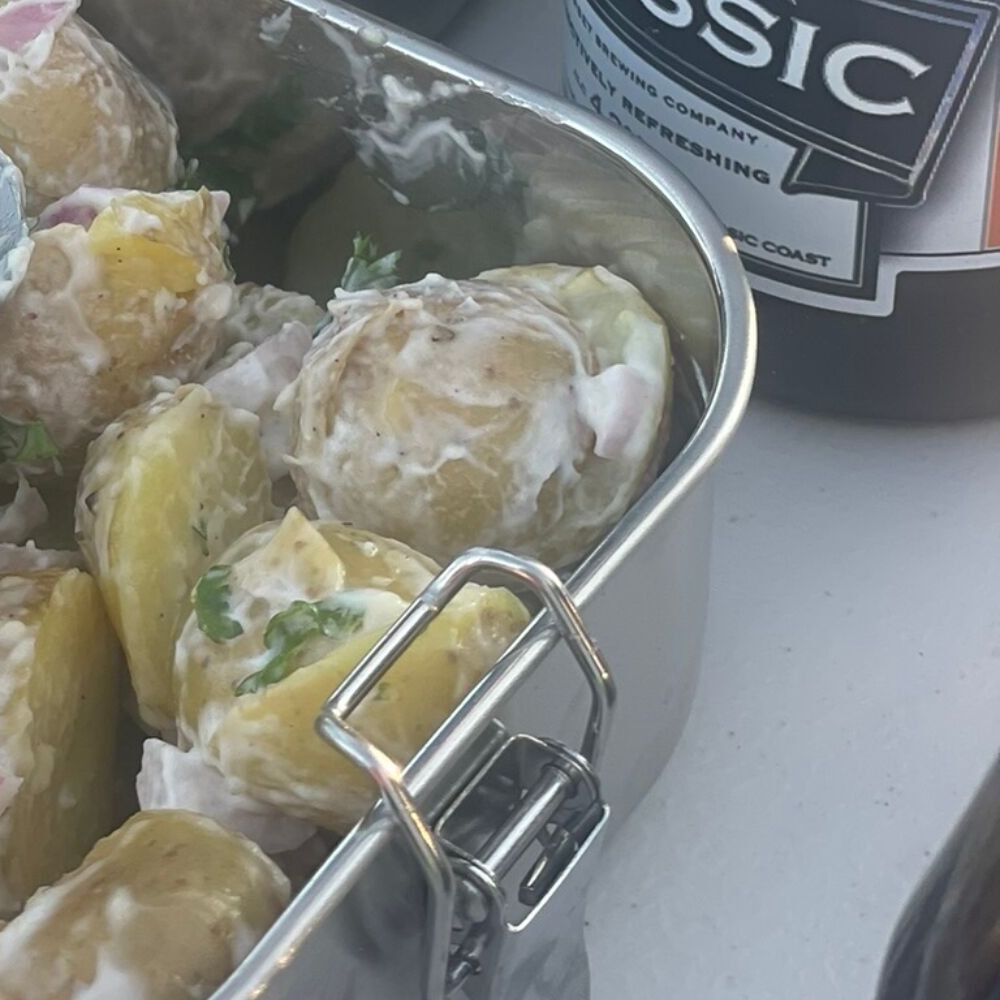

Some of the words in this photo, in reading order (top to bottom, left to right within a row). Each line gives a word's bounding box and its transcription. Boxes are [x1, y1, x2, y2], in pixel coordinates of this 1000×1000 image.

[594, 33, 660, 99] BREWING
[663, 95, 760, 146] COMPANY
[621, 95, 771, 186] REFRESHING
[761, 240, 832, 268] COAST
